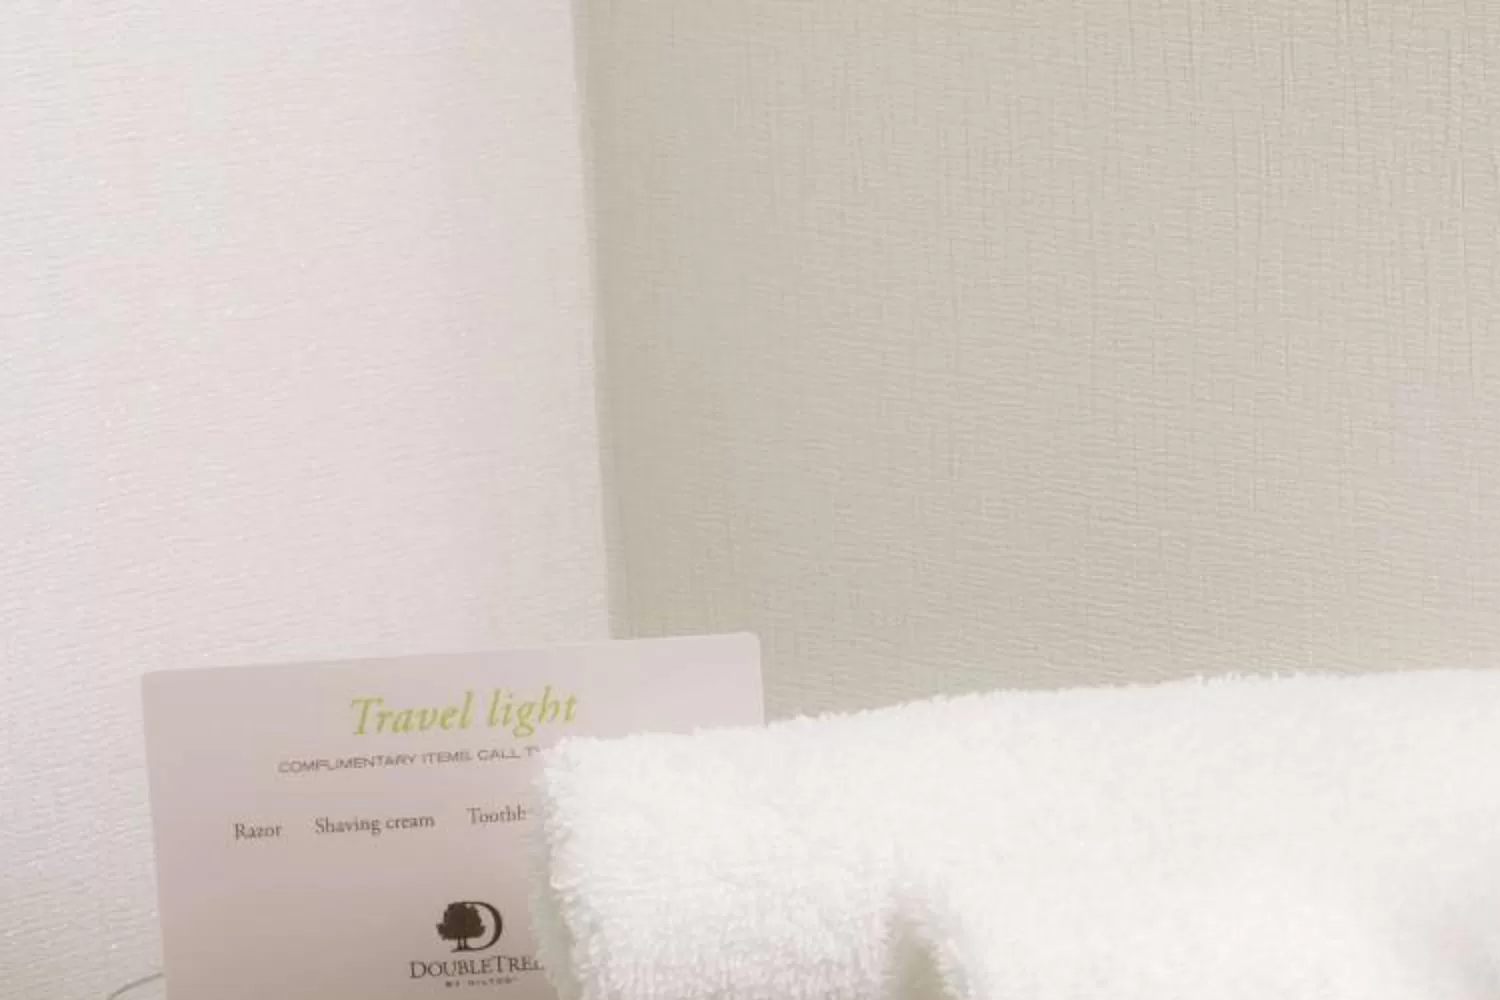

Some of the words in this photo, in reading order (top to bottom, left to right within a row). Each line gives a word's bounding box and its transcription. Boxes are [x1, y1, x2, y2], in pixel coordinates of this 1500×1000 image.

[350, 690, 474, 736] Travel
[486, 686, 578, 739] light
[477, 748, 521, 762] CALL
[524, 746, 541, 757] T
[314, 815, 381, 837] Shaving
[384, 814, 435, 831] cream
[465, 803, 529, 826] Toothb
[232, 821, 283, 841] Razor
